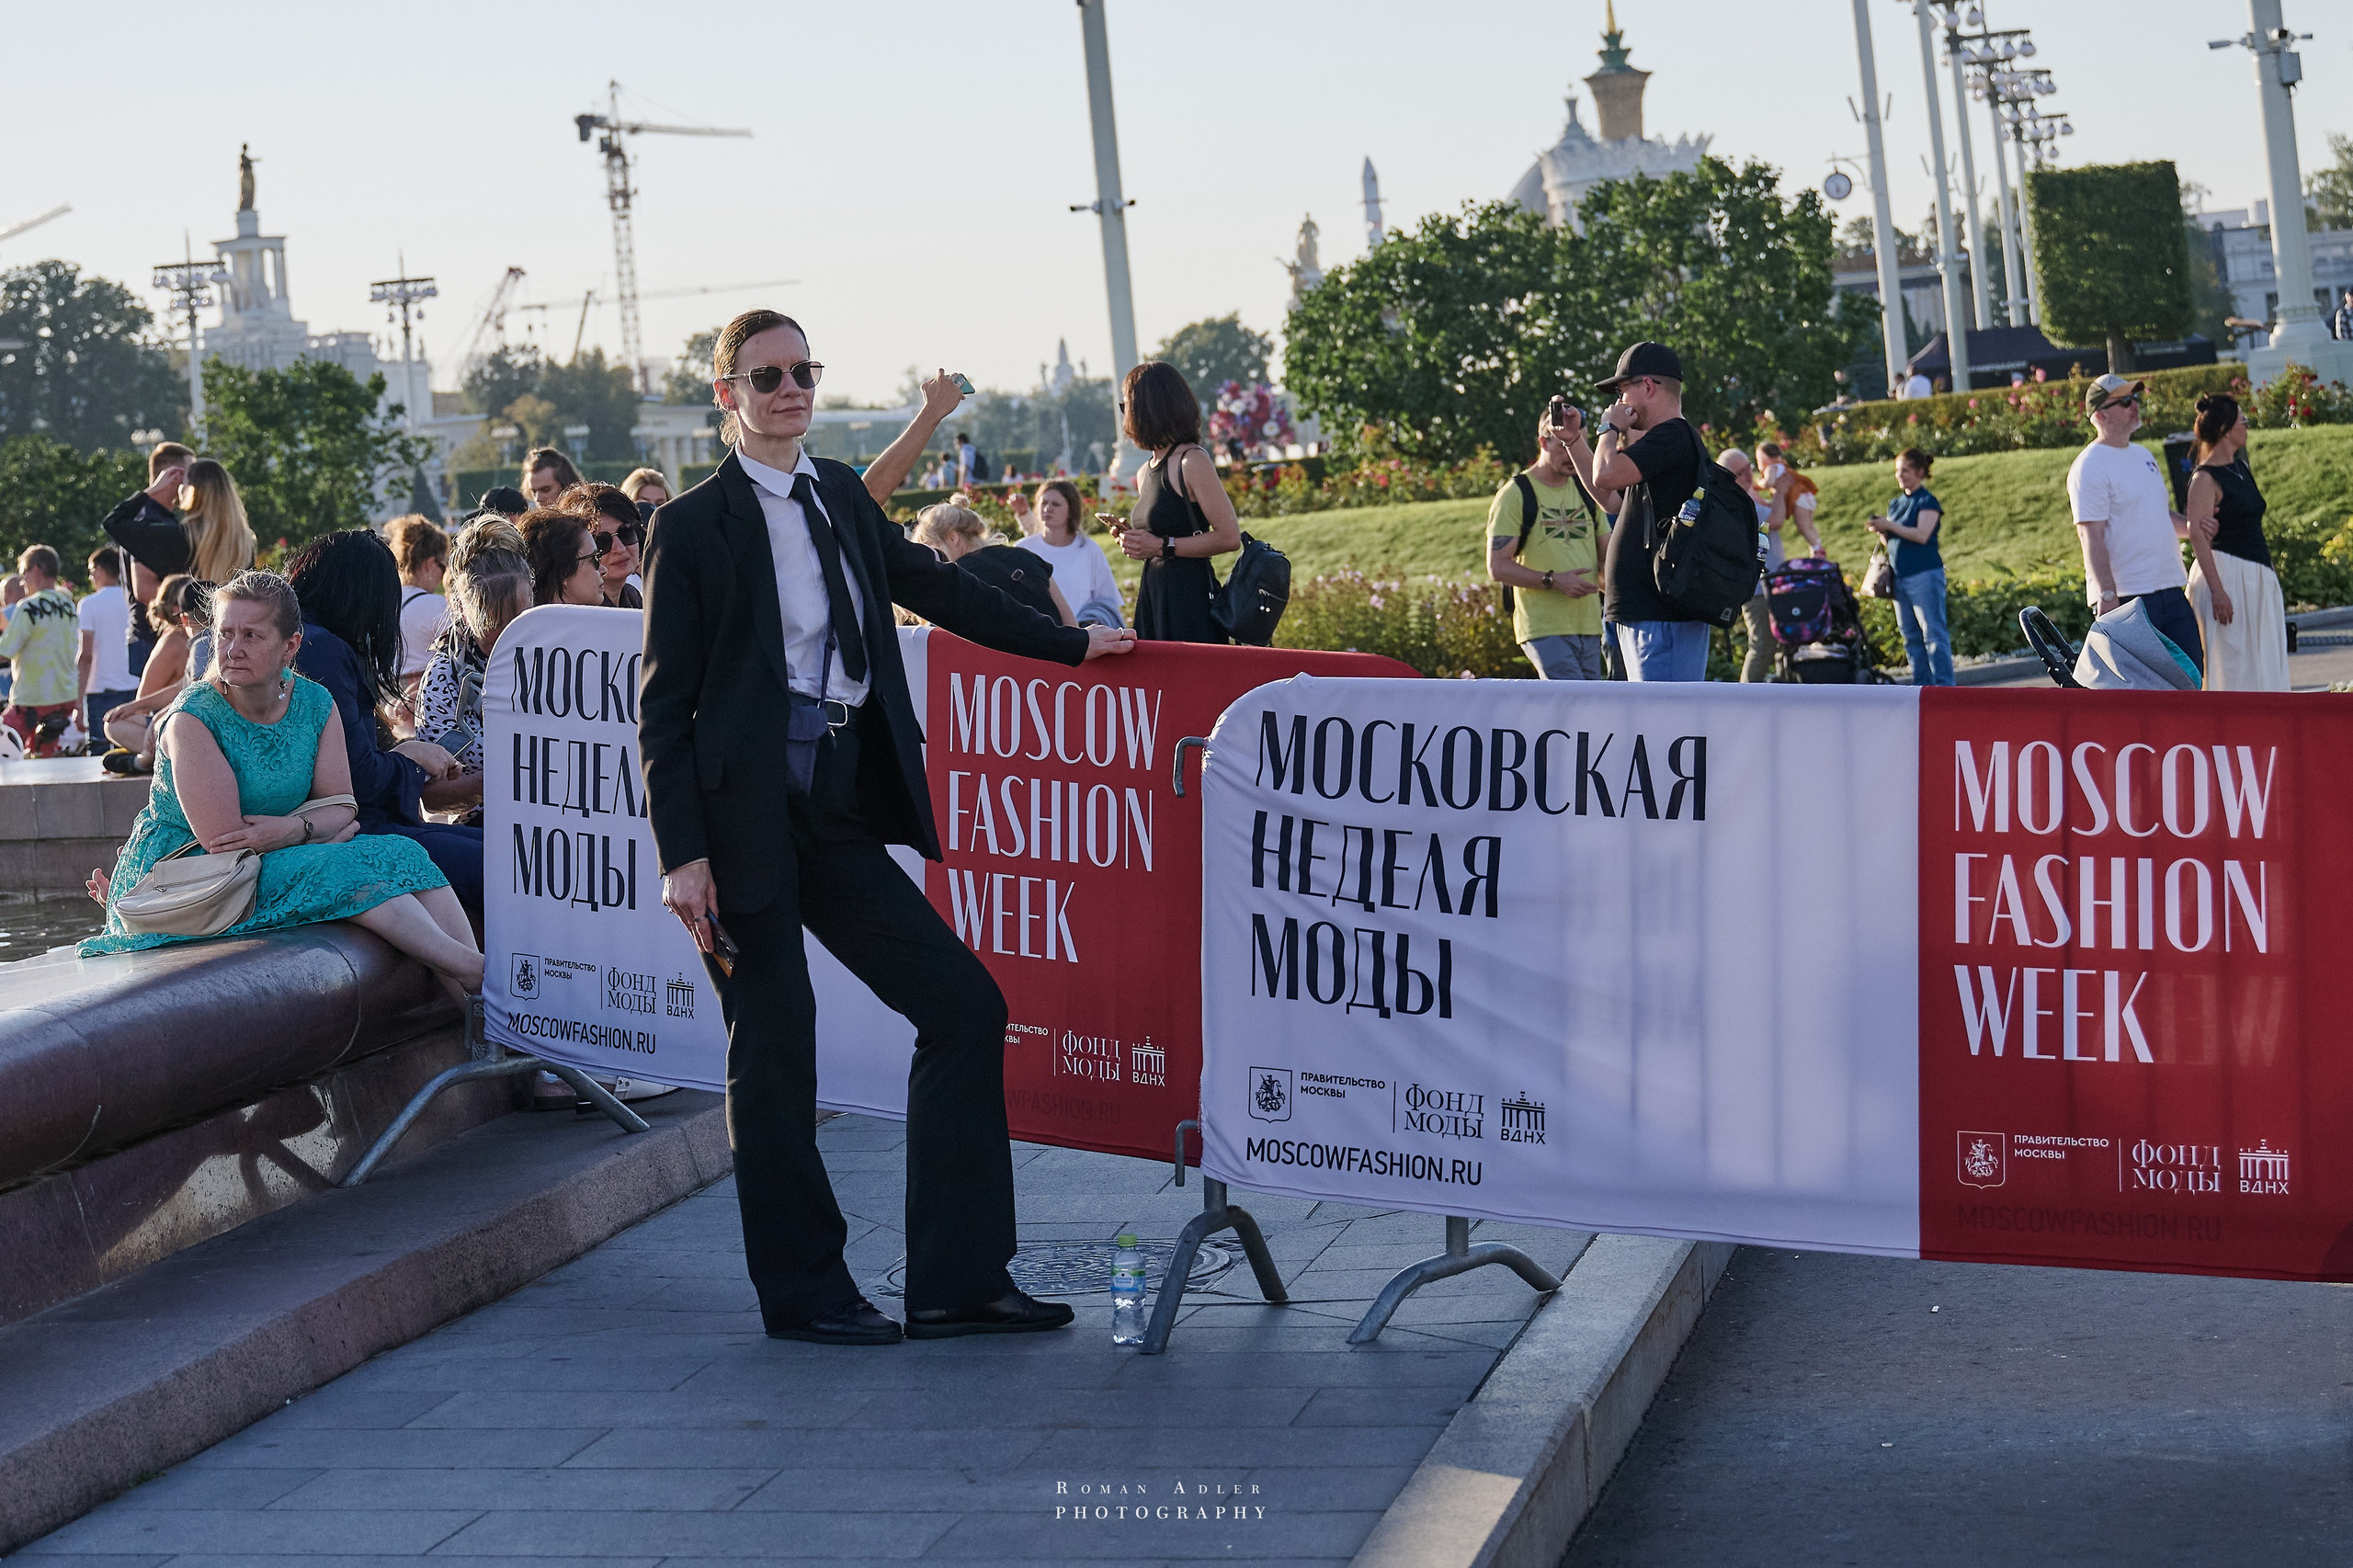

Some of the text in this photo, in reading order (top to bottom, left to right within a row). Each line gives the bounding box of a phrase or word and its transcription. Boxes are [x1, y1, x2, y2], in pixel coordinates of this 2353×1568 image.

[949, 673, 1162, 771] MOSCOW
[513, 733, 650, 818] НЕДЕЛ
[1256, 710, 1708, 822] МОСКОВСКАЯ
[1955, 740, 2277, 839] MOSCOW
[949, 771, 1153, 871] FASHION
[513, 824, 636, 912] МОДЫ
[1252, 810, 1502, 918] НЕДЕЛЯ
[948, 869, 1079, 963] WEEK
[1955, 853, 2268, 954] FASHION
[544, 958, 597, 972] ПРАВИТЕЛЬСТВО
[544, 968, 573, 981] МОСКВЫ
[1252, 913, 1452, 1020] МОДЫ
[607, 967, 656, 996] ФОНД
[607, 990, 656, 1016] МОДЫ
[666, 1005, 695, 1019] ВДНХ
[1954, 965, 2154, 1063] WEEK
[507, 1012, 656, 1054] MOSCOWFASHION.RU
[1063, 1029, 1120, 1063] ФОНД
[1063, 1055, 1120, 1083] МОДЫ
[1132, 1072, 1165, 1087] ВДНХ
[1301, 1072, 1386, 1089] ПРАВИТЕЛЬСТВО
[1300, 1085, 1347, 1099] МОСКВЫ
[1404, 1083, 1484, 1119] ФОНД
[1404, 1110, 1483, 1140] МОДЫ
[1500, 1129, 1546, 1144] ВДНХ
[2014, 1134, 2109, 1148] ПРАВИТЕЛЬСТВО
[1246, 1137, 1483, 1186] MOSCOWFASHION.RU
[2014, 1148, 2065, 1159] МОСКВЫ
[2131, 1139, 2221, 1170] ФОНД
[2132, 1168, 2221, 1195] МОДЫ
[2239, 1179, 2290, 1195] ВДНХ
[1957, 1204, 2222, 1242] MOSCOWFASHION.RU
